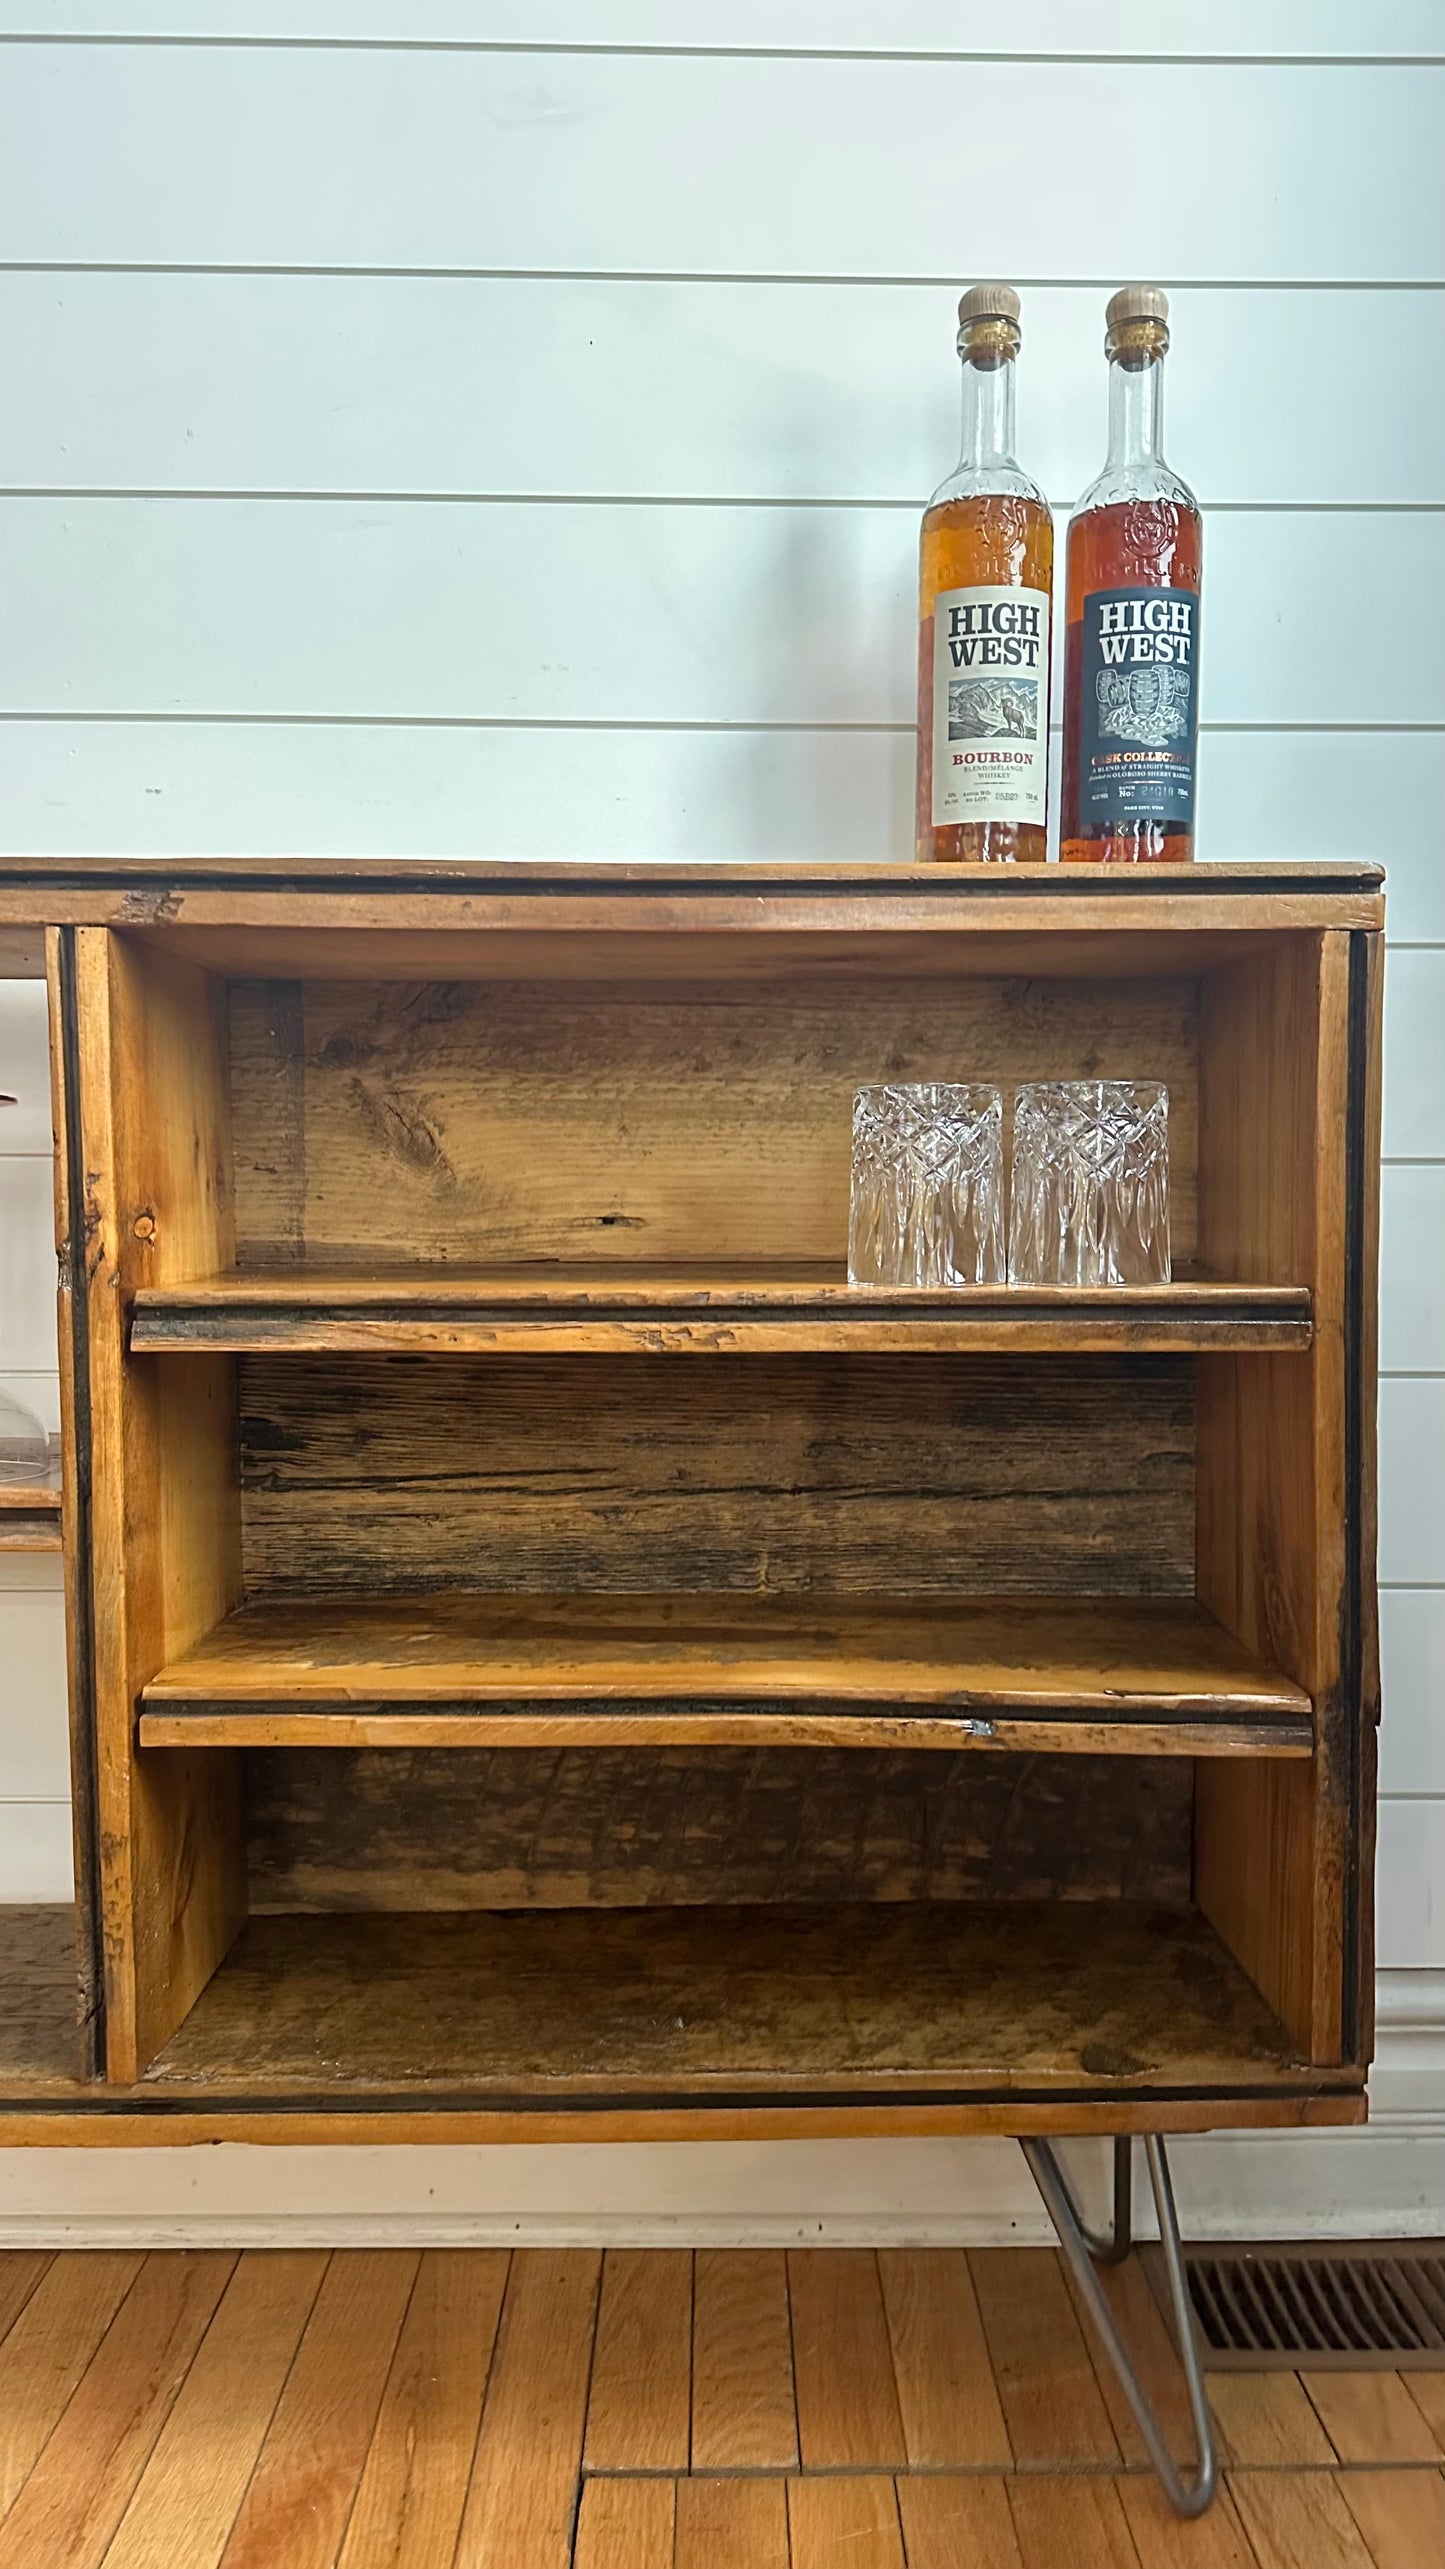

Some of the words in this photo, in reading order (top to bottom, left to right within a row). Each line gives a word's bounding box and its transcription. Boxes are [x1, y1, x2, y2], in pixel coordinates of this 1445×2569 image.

[948, 602, 1040, 638] HIGH
[1099, 600, 1192, 635] HIGH
[948, 636, 1039, 668] WEST
[1099, 633, 1190, 664] WEST
[952, 752, 1034, 766] BOURBON
[1091, 753, 1122, 766] CSK
[963, 764, 1024, 772] BLEND/MÉLANGE
[1097, 765, 1120, 773] BLEND
[1119, 790, 1135, 798] No:
